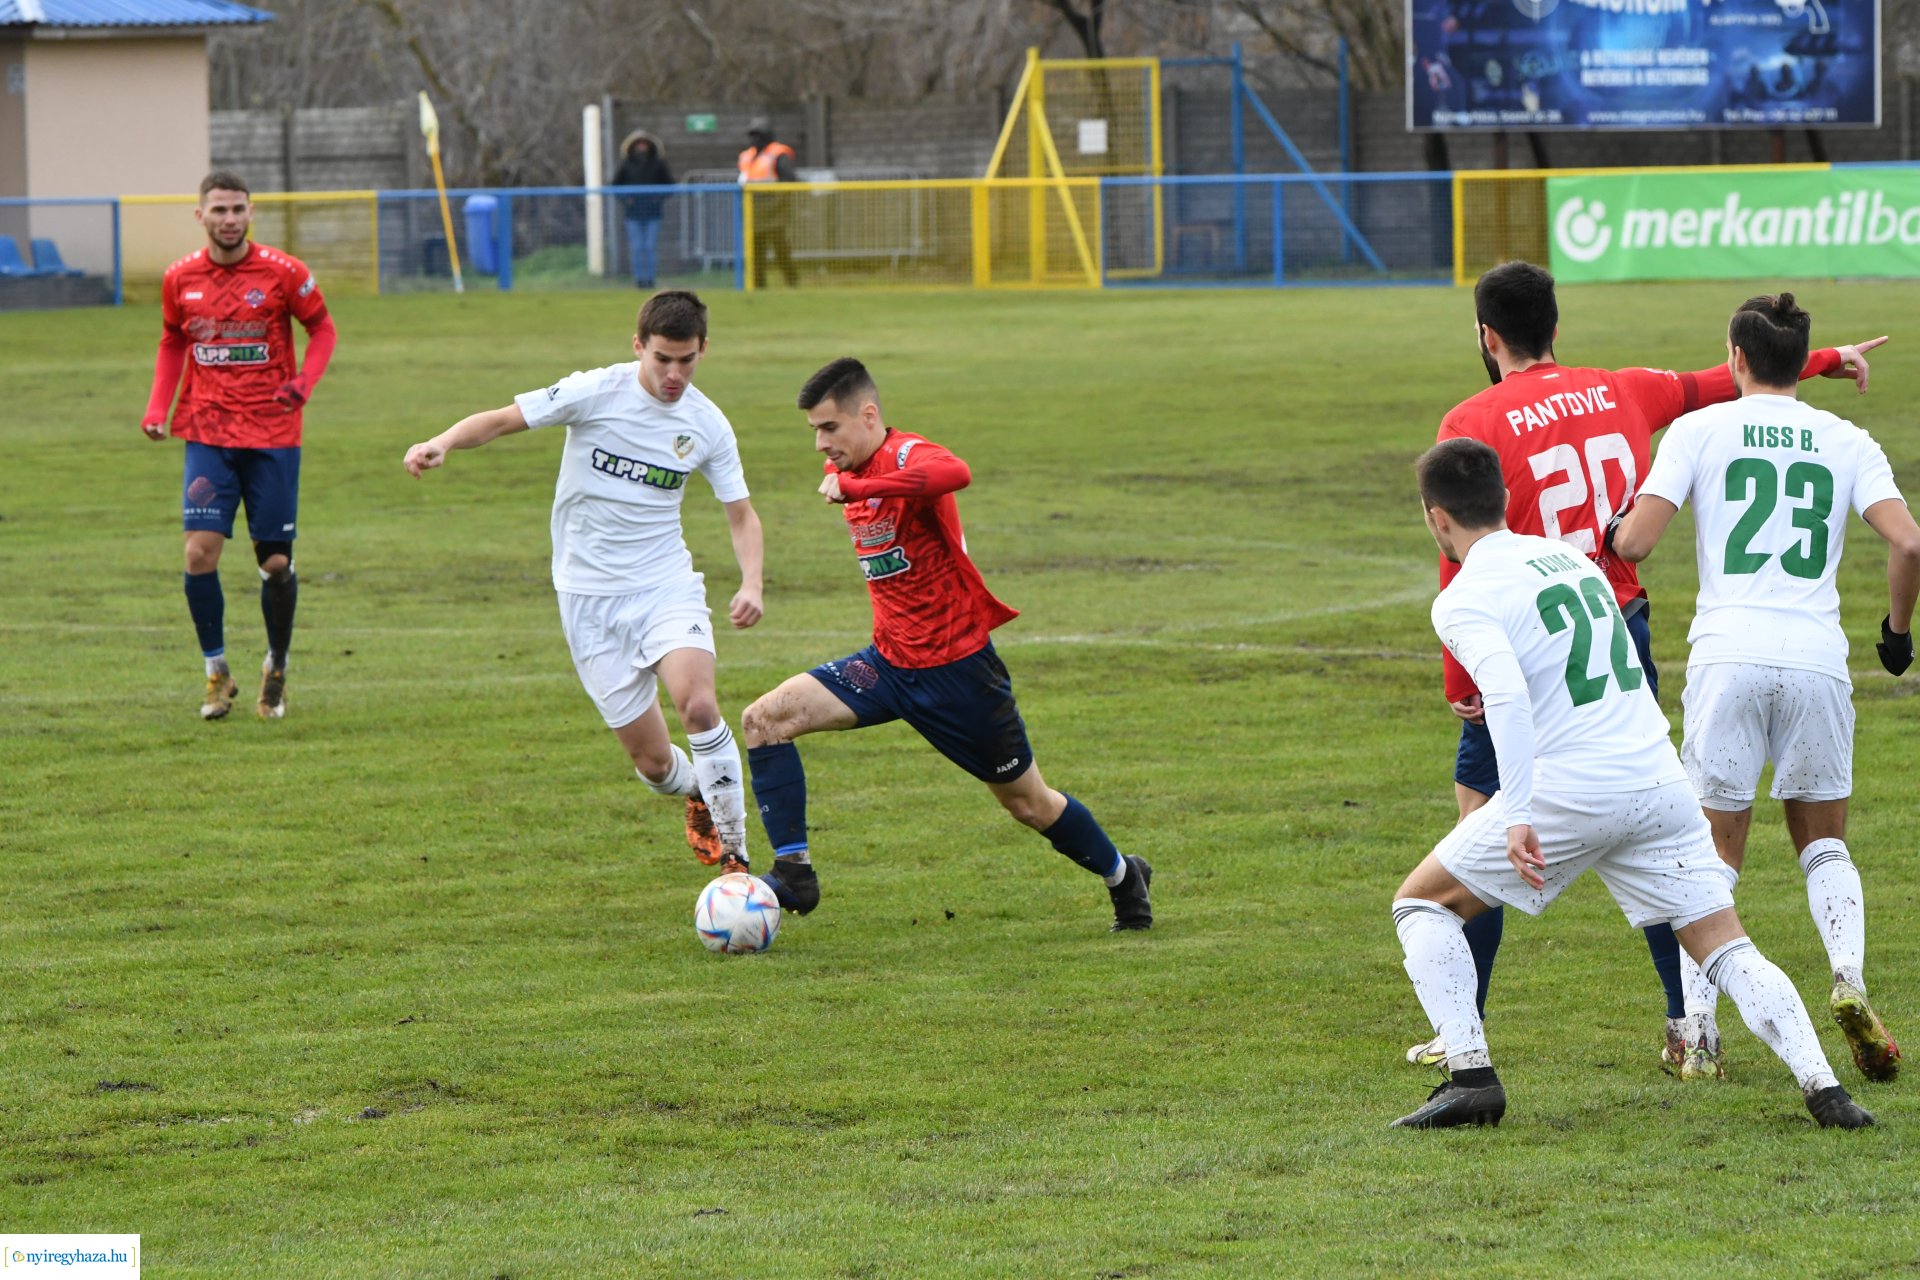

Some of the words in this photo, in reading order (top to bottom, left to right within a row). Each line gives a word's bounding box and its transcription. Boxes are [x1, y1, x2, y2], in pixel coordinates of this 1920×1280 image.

[1506, 385, 1616, 436] PANTOVIC
[1743, 424, 1794, 448] KISS
[1800, 429, 1819, 453] B.
[1527, 432, 1637, 554] 20
[1723, 457, 1834, 580] 23
[1536, 576, 1643, 708] 22
